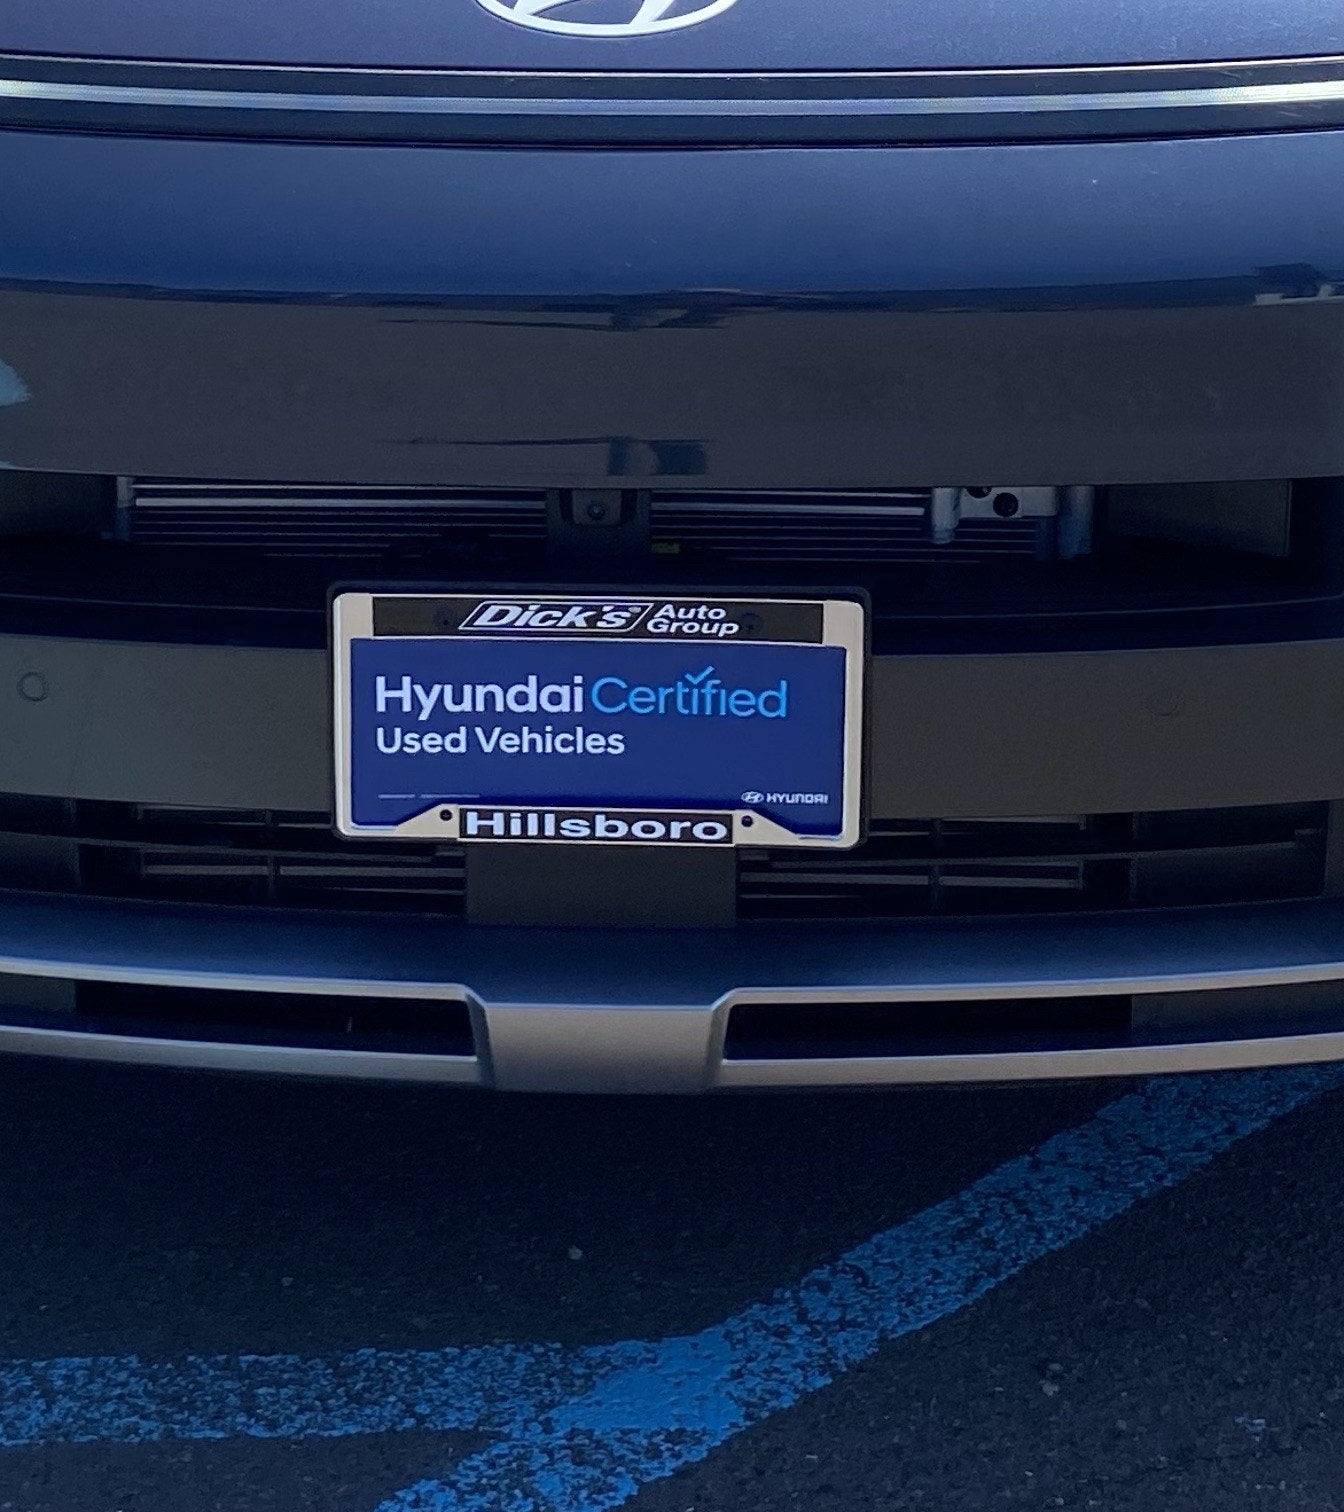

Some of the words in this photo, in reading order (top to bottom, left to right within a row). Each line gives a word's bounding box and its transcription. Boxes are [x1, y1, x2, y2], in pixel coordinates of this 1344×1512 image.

[473, 604, 632, 628] Dick's
[654, 603, 727, 619] Auto
[646, 617, 739, 637] Group
[375, 675, 584, 721] Hyundai
[591, 674, 788, 717] Certified
[376, 727, 468, 754] Used
[474, 725, 625, 755] Vehicles
[766, 792, 829, 804] HYUNDAI
[466, 811, 728, 840] Hillsboro
